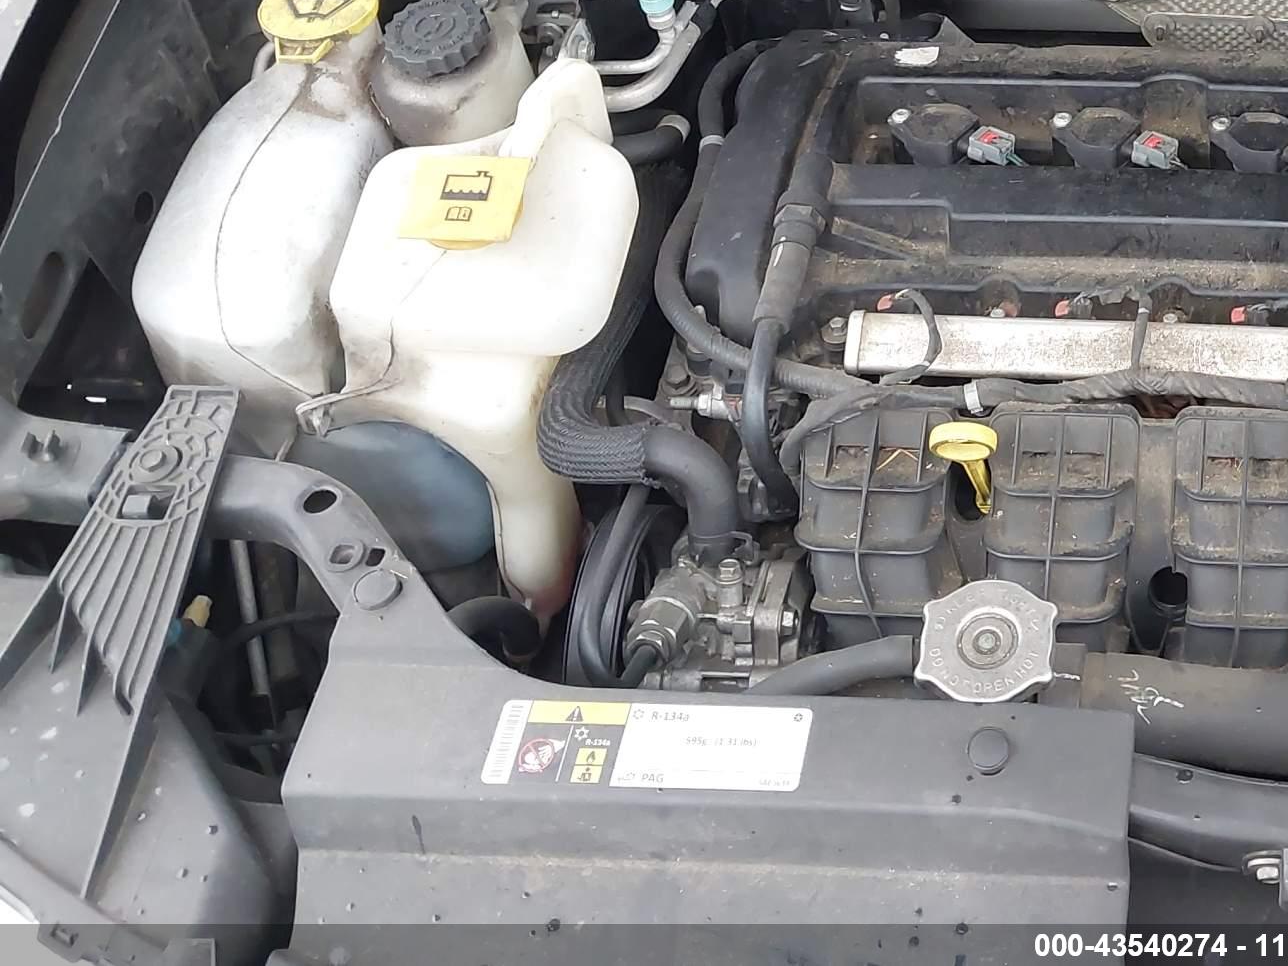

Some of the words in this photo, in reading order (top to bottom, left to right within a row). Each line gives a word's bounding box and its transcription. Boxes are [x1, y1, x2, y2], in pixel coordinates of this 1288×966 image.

[651, 711, 689, 722] R-134a
[585, 738, 610, 746] R-134a
[642, 773, 664, 783] PAG
